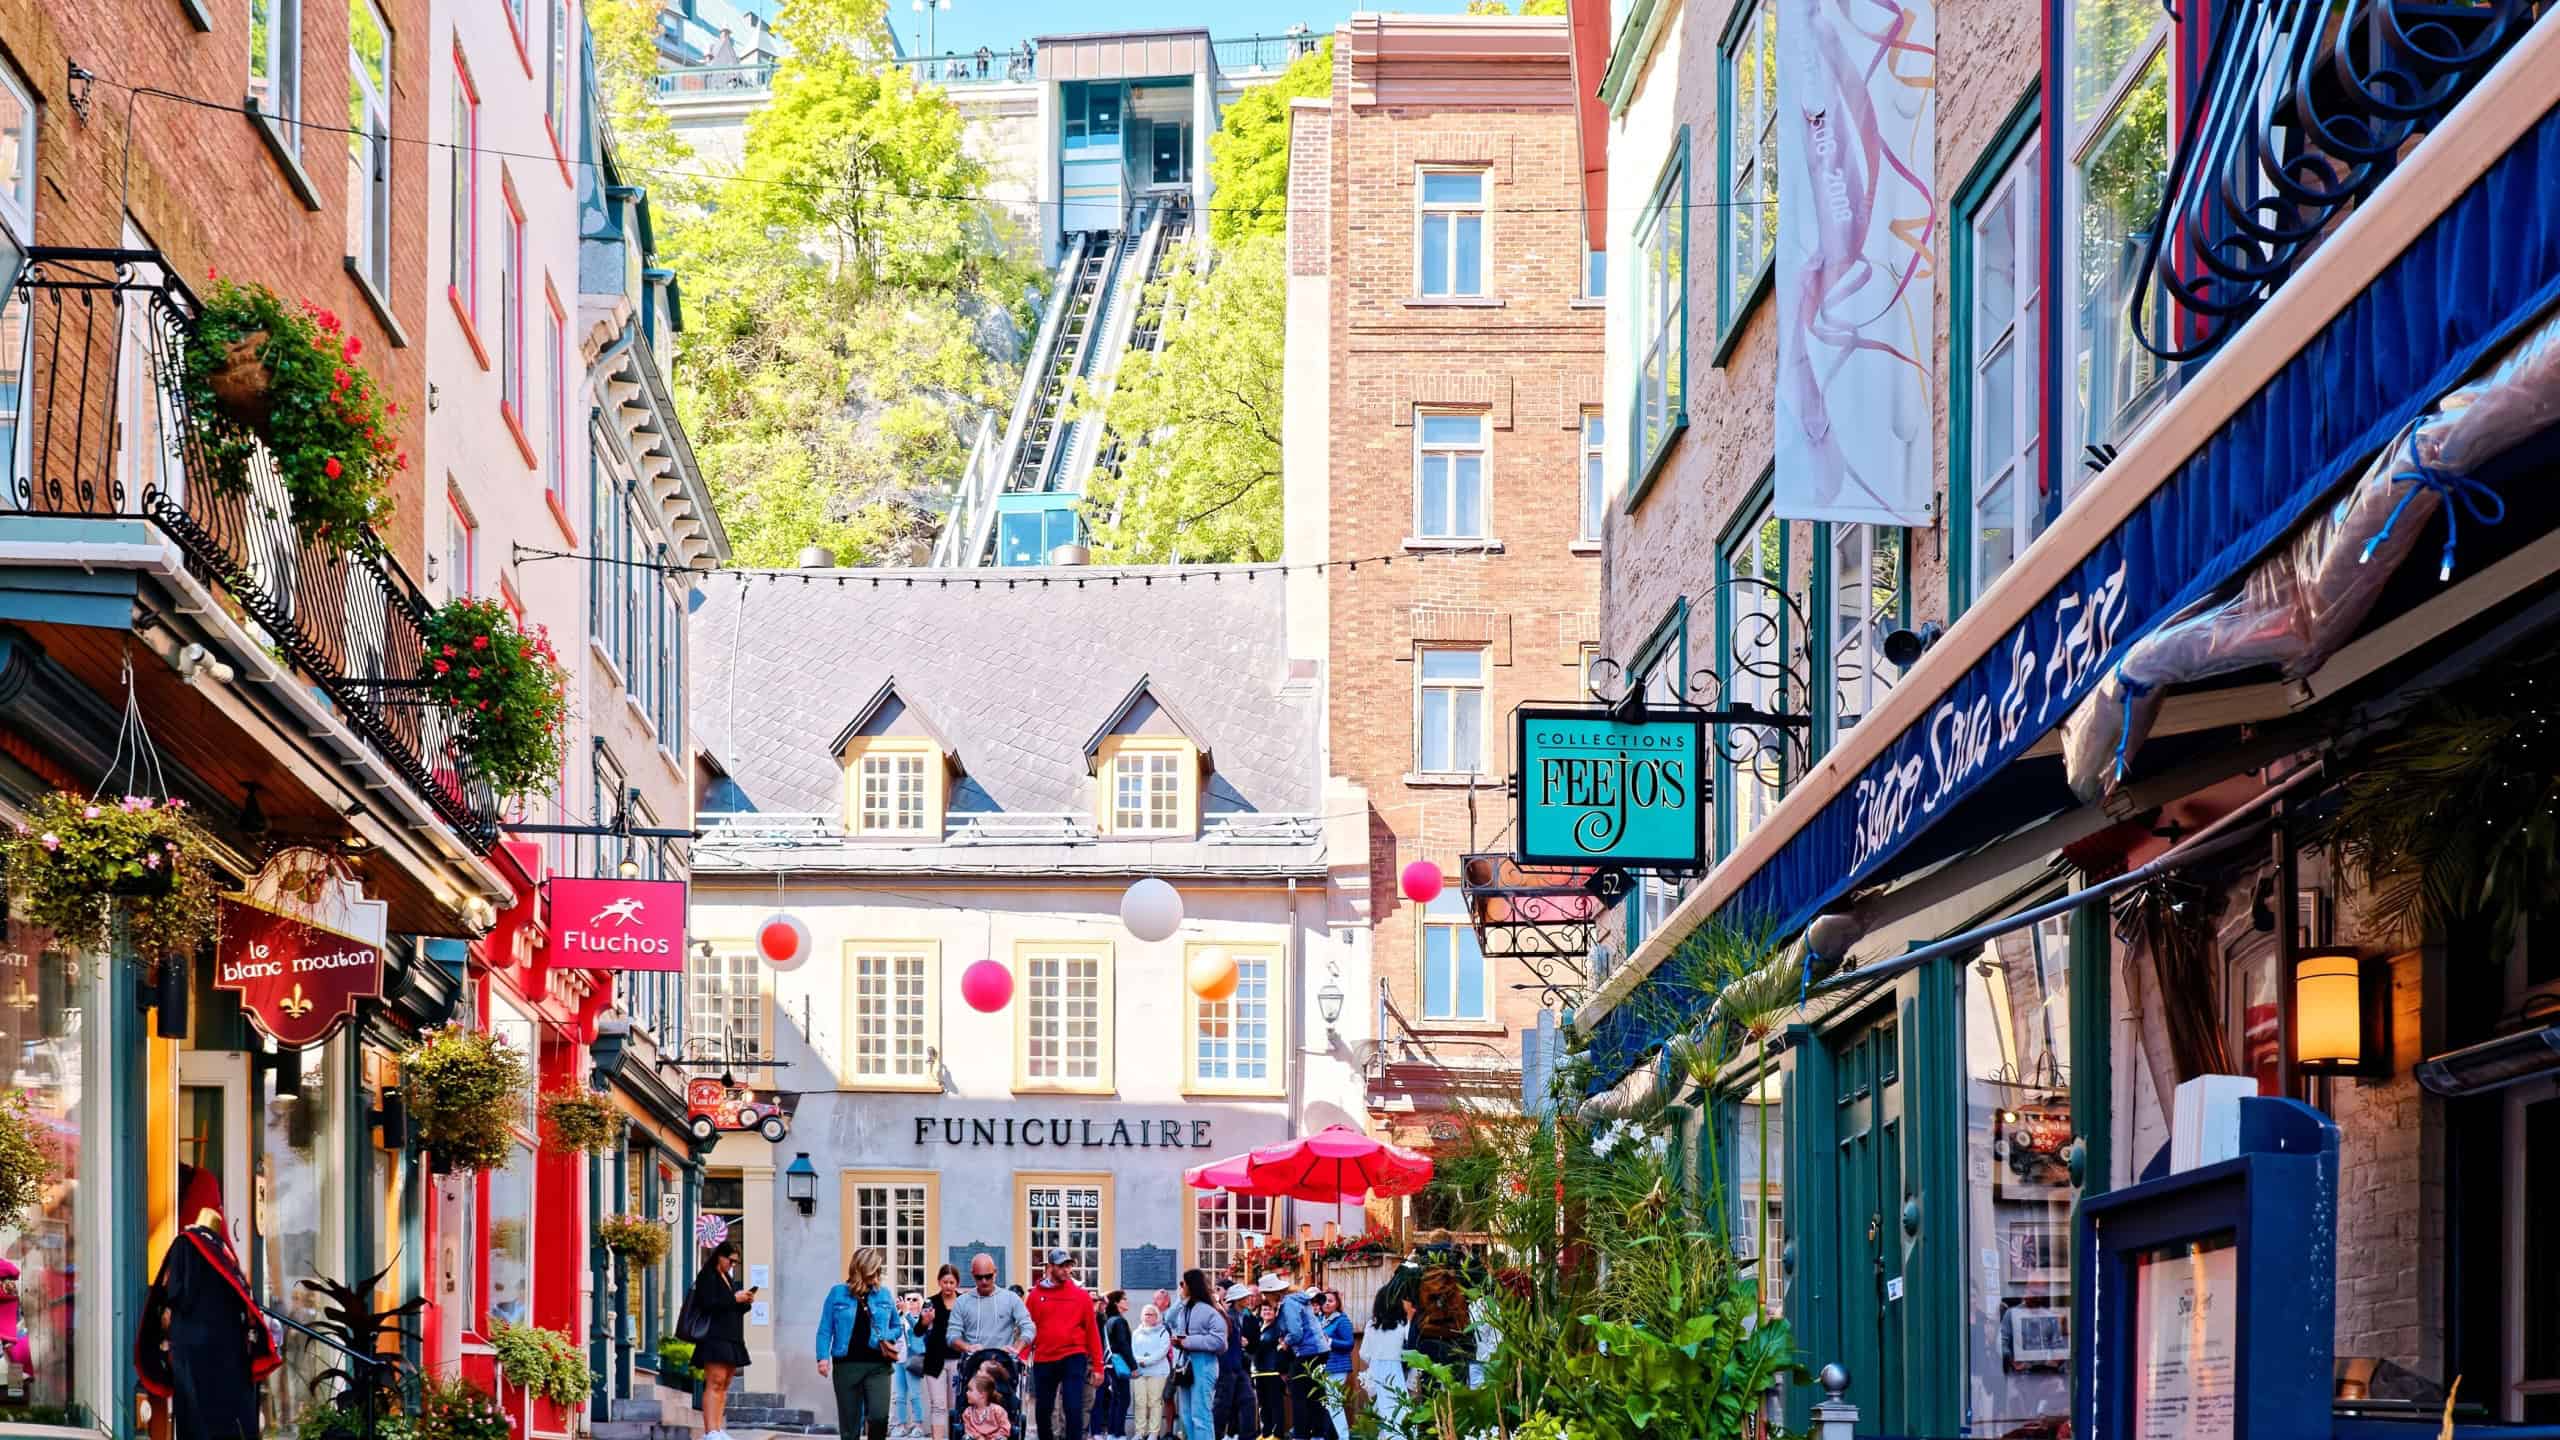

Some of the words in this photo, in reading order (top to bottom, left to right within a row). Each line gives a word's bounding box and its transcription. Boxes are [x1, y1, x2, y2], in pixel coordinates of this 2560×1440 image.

[1536, 733, 1686, 747] COLLECTIONS
[1602, 873, 1621, 895] 52
[248, 940, 270, 960] le
[563, 930, 671, 954] Fluchos
[223, 961, 283, 982] blanc
[291, 948, 376, 973] mouton
[914, 1117, 1213, 1148] FUNICULAIRE
[665, 1197, 677, 1208] 59
